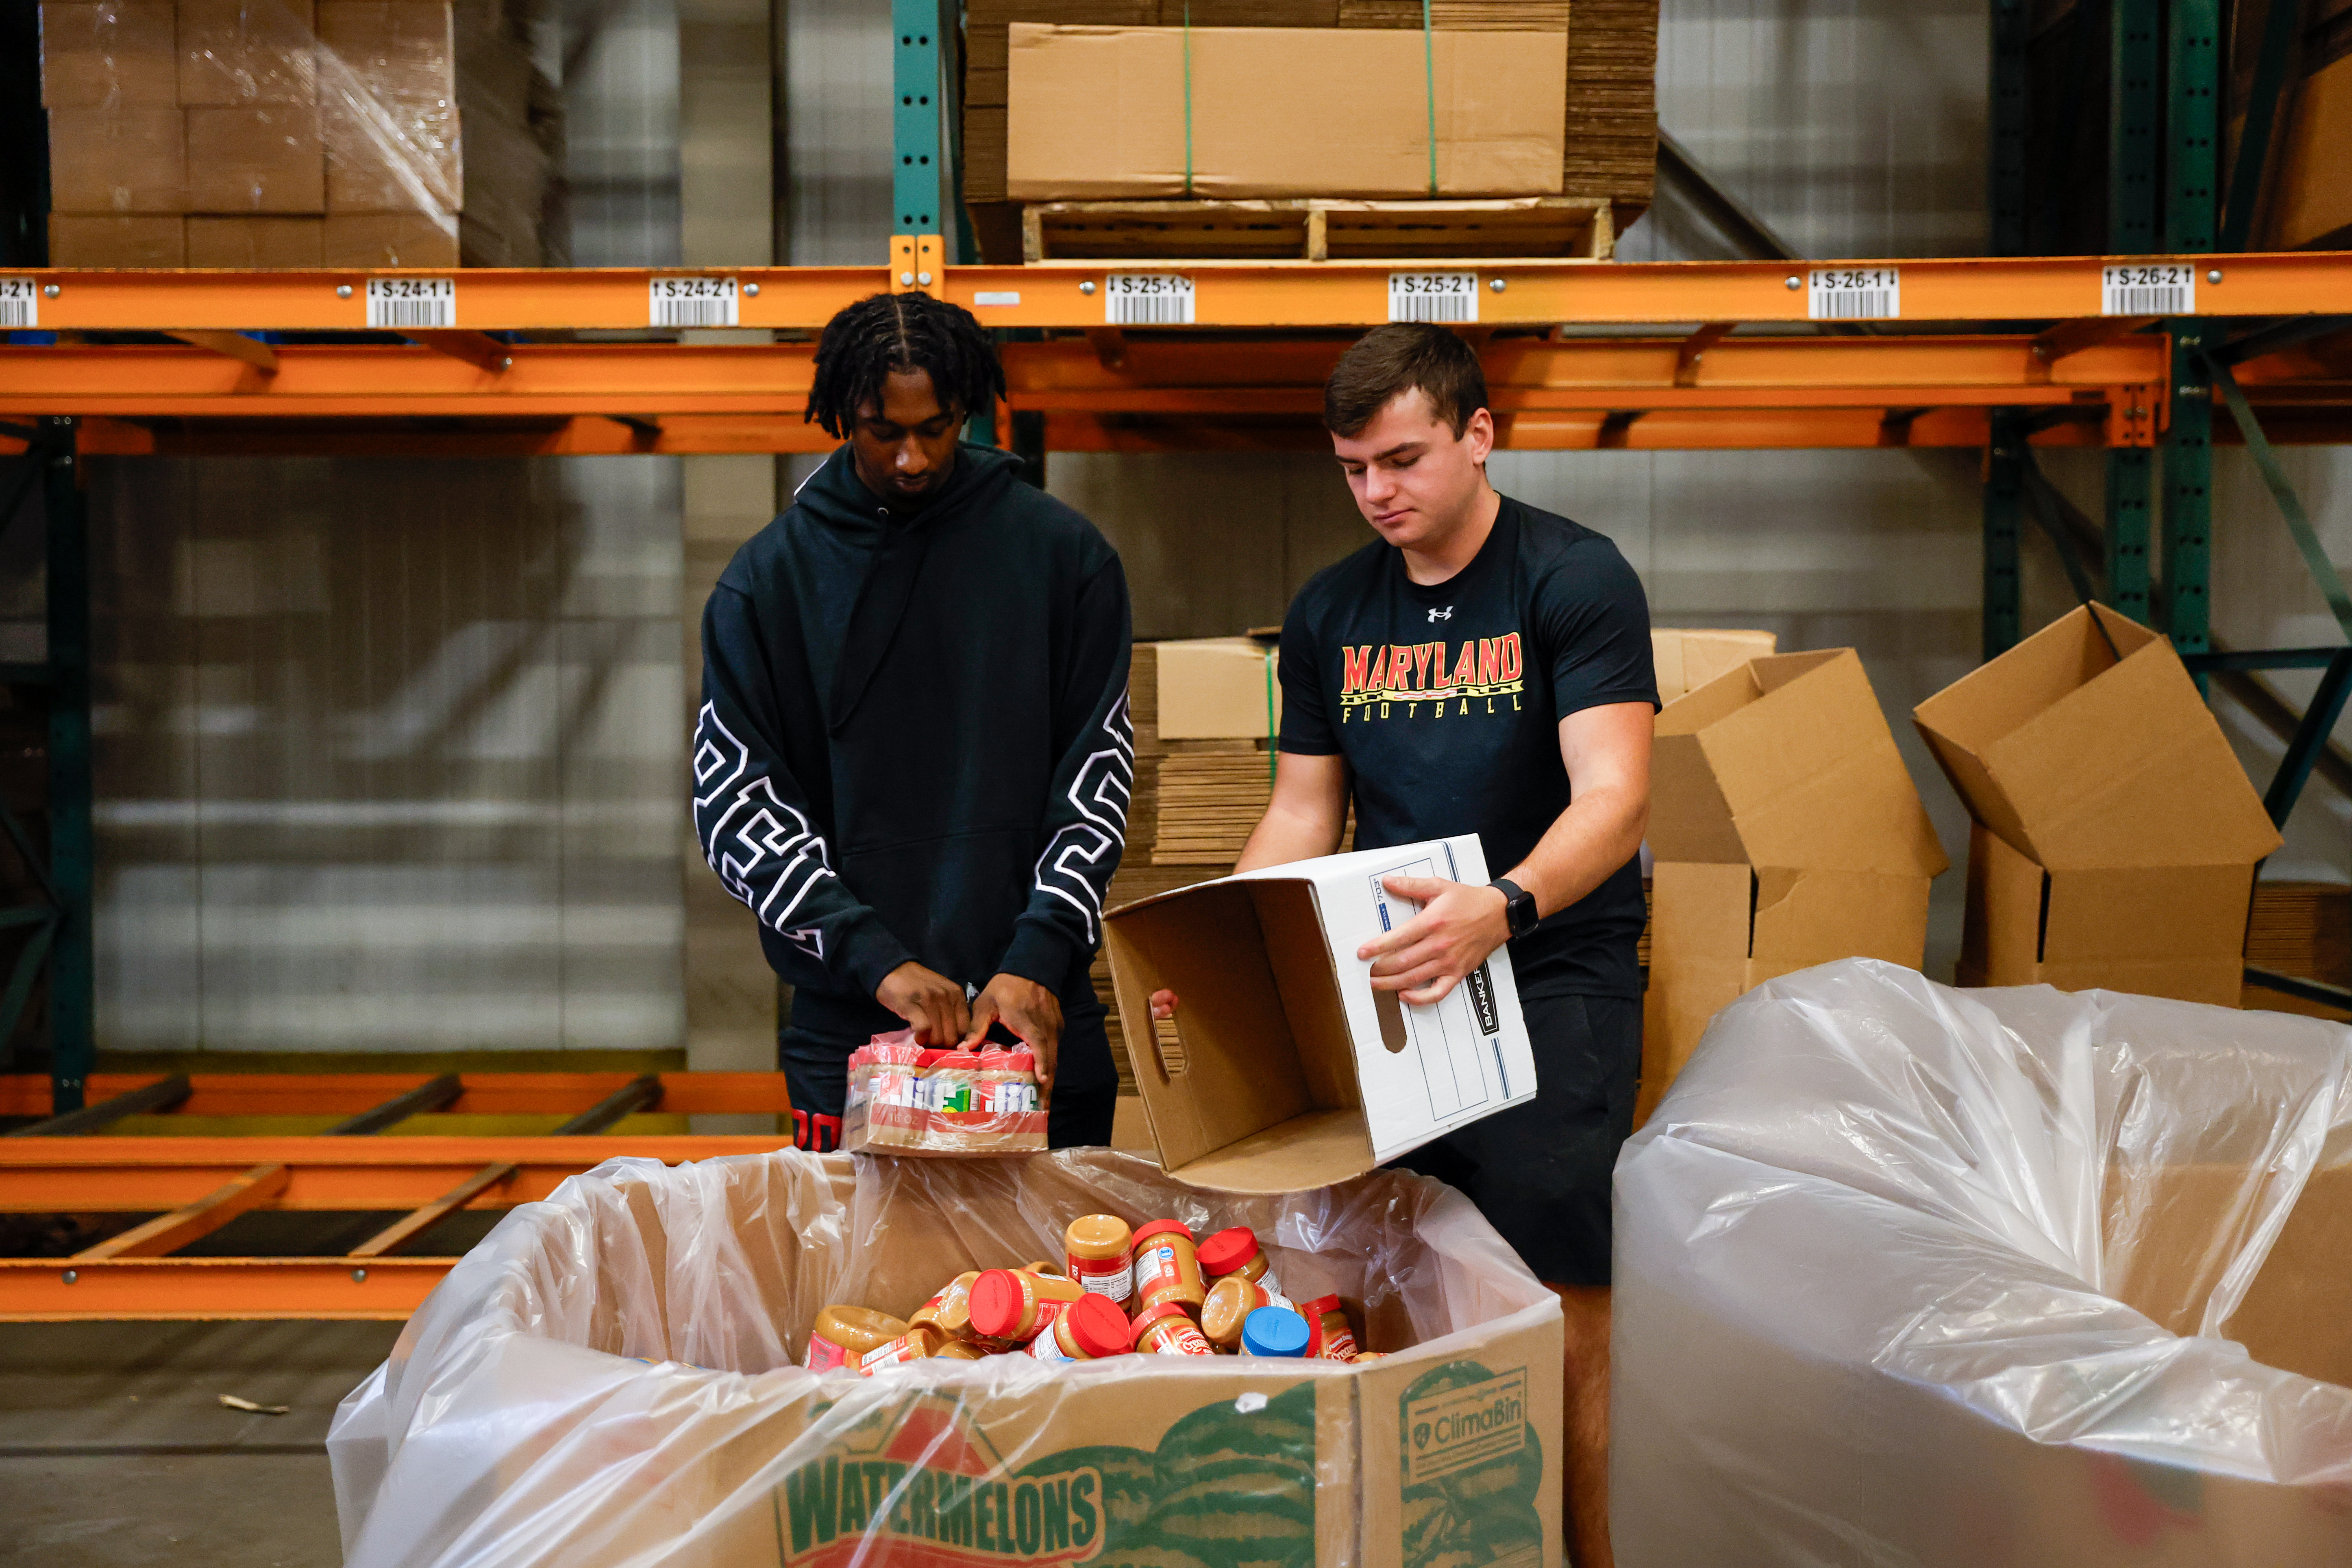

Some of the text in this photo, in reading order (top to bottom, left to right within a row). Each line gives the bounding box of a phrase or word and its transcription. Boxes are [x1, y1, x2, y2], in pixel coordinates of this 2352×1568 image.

[1123, 277, 1176, 294] S-25-1
[1405, 276, 1461, 293] S-25-2
[1826, 272, 1881, 288] S-26-1
[2120, 269, 2178, 285] S-26-2
[383, 281, 436, 297] S-24-1
[666, 281, 722, 297] S-24-2
[1341, 632, 1522, 694] MARYLAND
[1343, 694, 1521, 724] FOOTBALL
[1435, 1396, 1521, 1444] ClimaBin
[785, 1455, 1098, 1555] WATERMELONS
